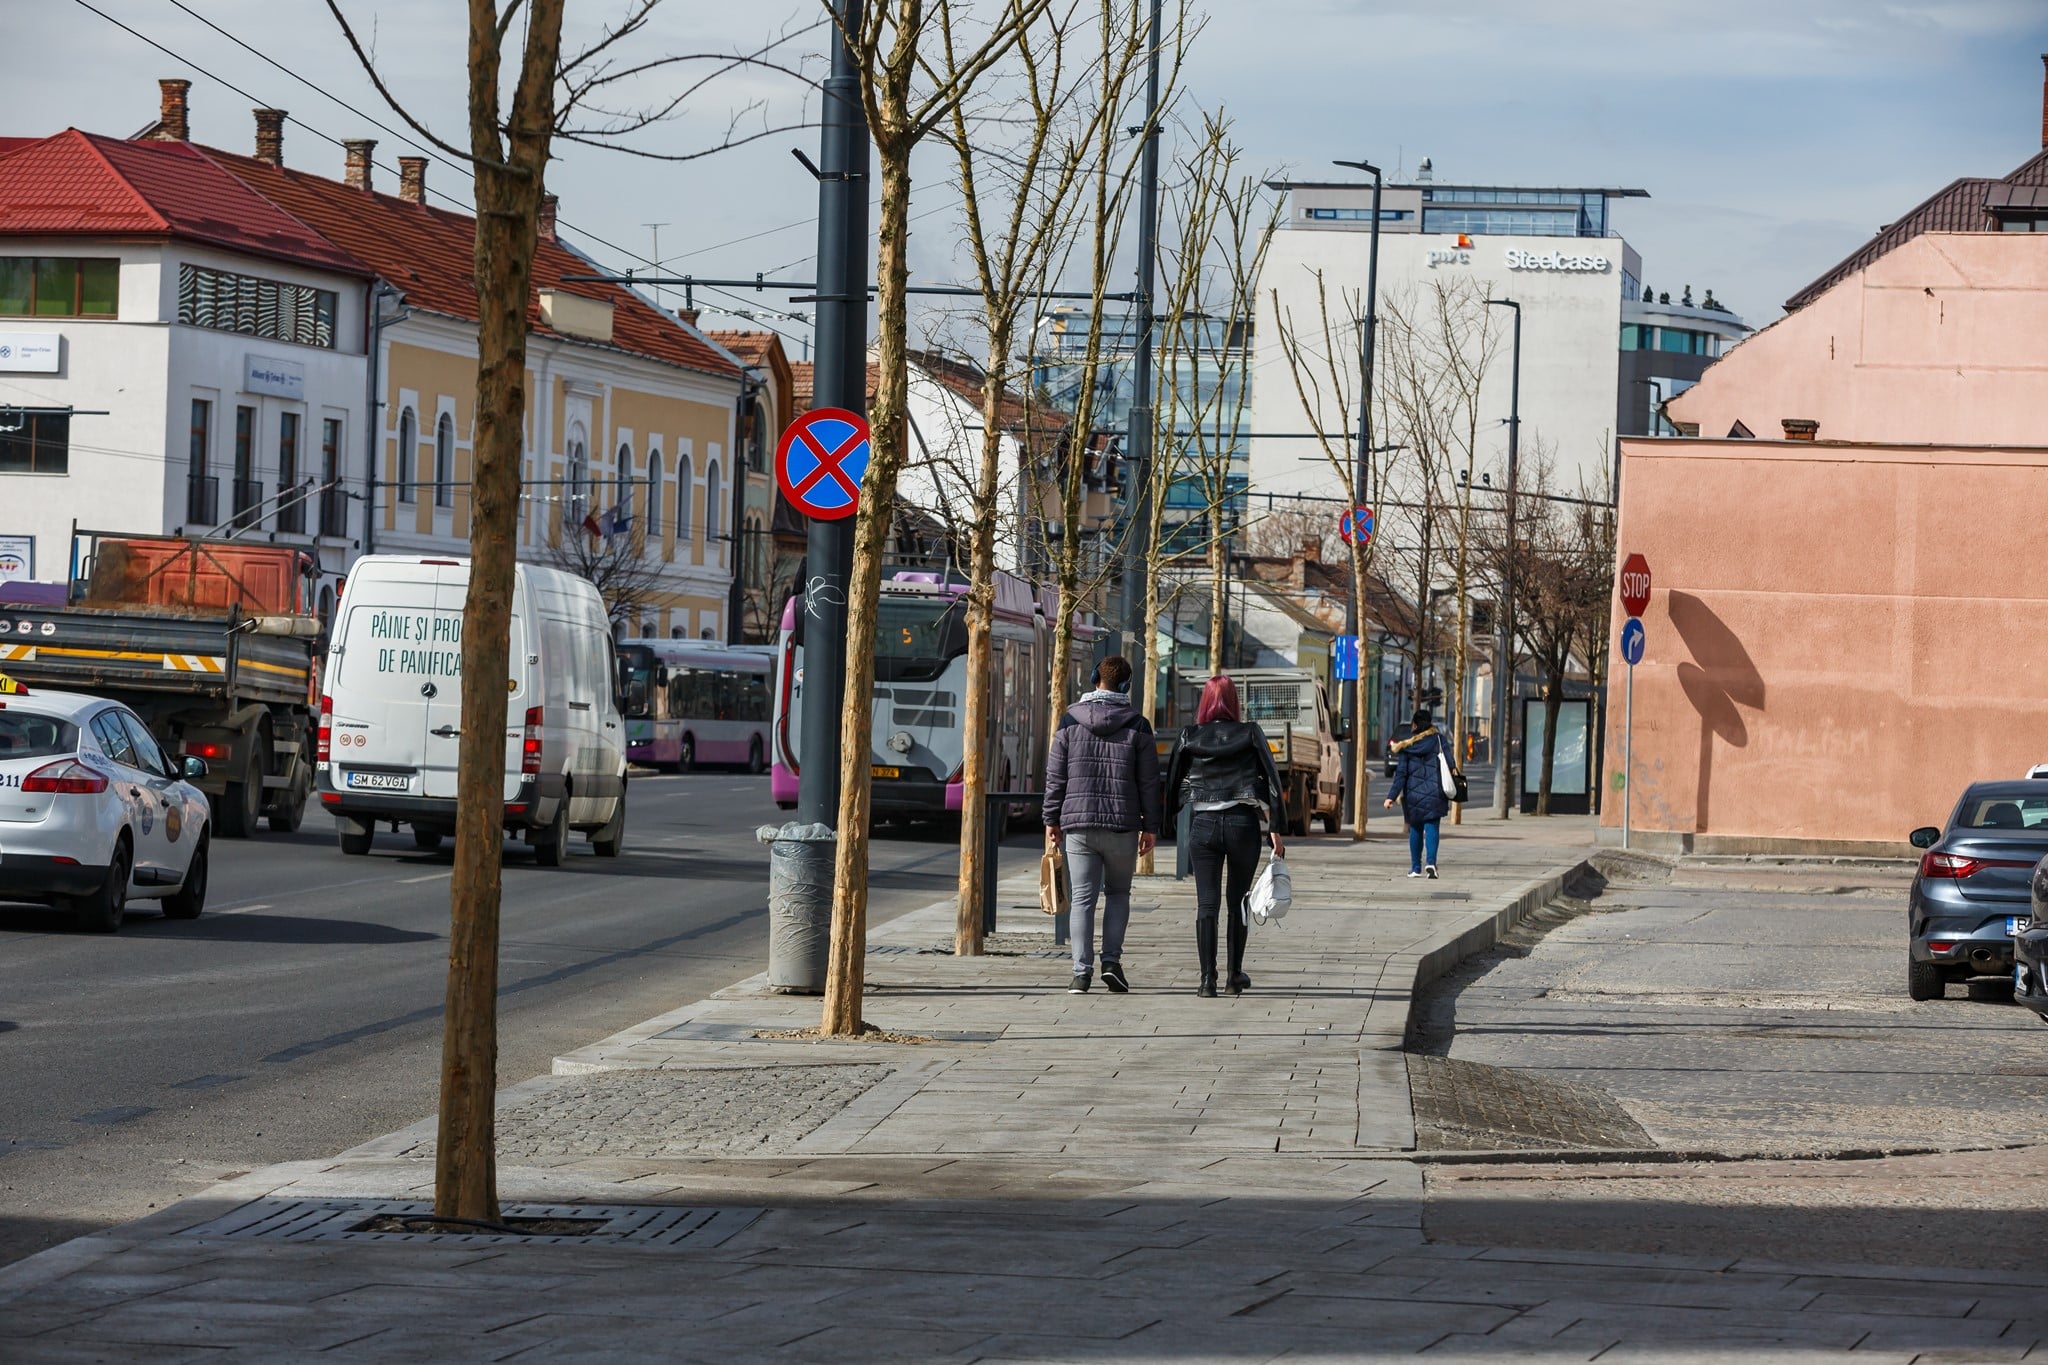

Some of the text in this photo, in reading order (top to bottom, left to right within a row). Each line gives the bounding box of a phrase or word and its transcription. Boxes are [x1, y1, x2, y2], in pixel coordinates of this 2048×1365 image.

[1426, 250, 1469, 268] pwc
[1504, 248, 1608, 271] Steelcase
[1623, 572, 1650, 599] STOP
[371, 610, 411, 640] PÂINE
[902, 627, 912, 643] 5
[379, 648, 396, 673] DE
[354, 774, 369, 786] SM
